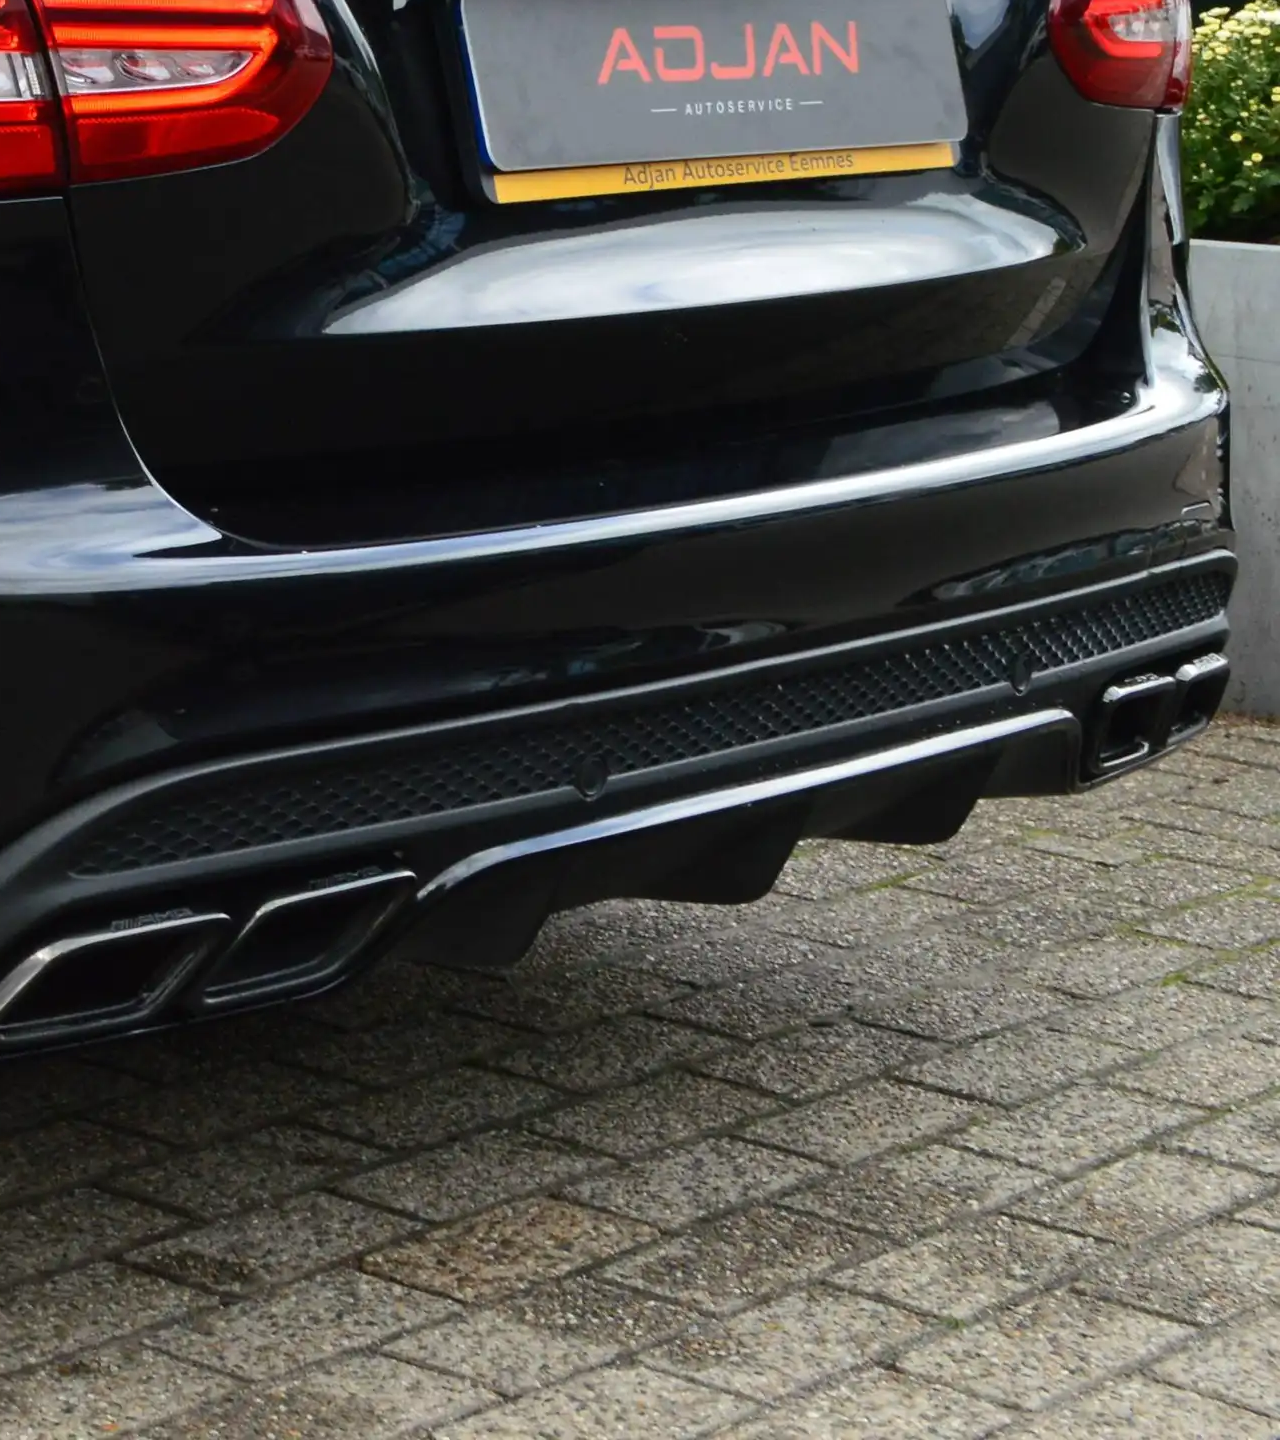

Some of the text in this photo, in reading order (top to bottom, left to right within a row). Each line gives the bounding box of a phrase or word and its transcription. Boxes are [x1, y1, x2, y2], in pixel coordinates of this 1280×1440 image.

[597, 20, 860, 85] ADJAN
[684, 97, 794, 116] AUTOSERVICE
[622, 151, 855, 190] Adjan Autoservice Eemnes
